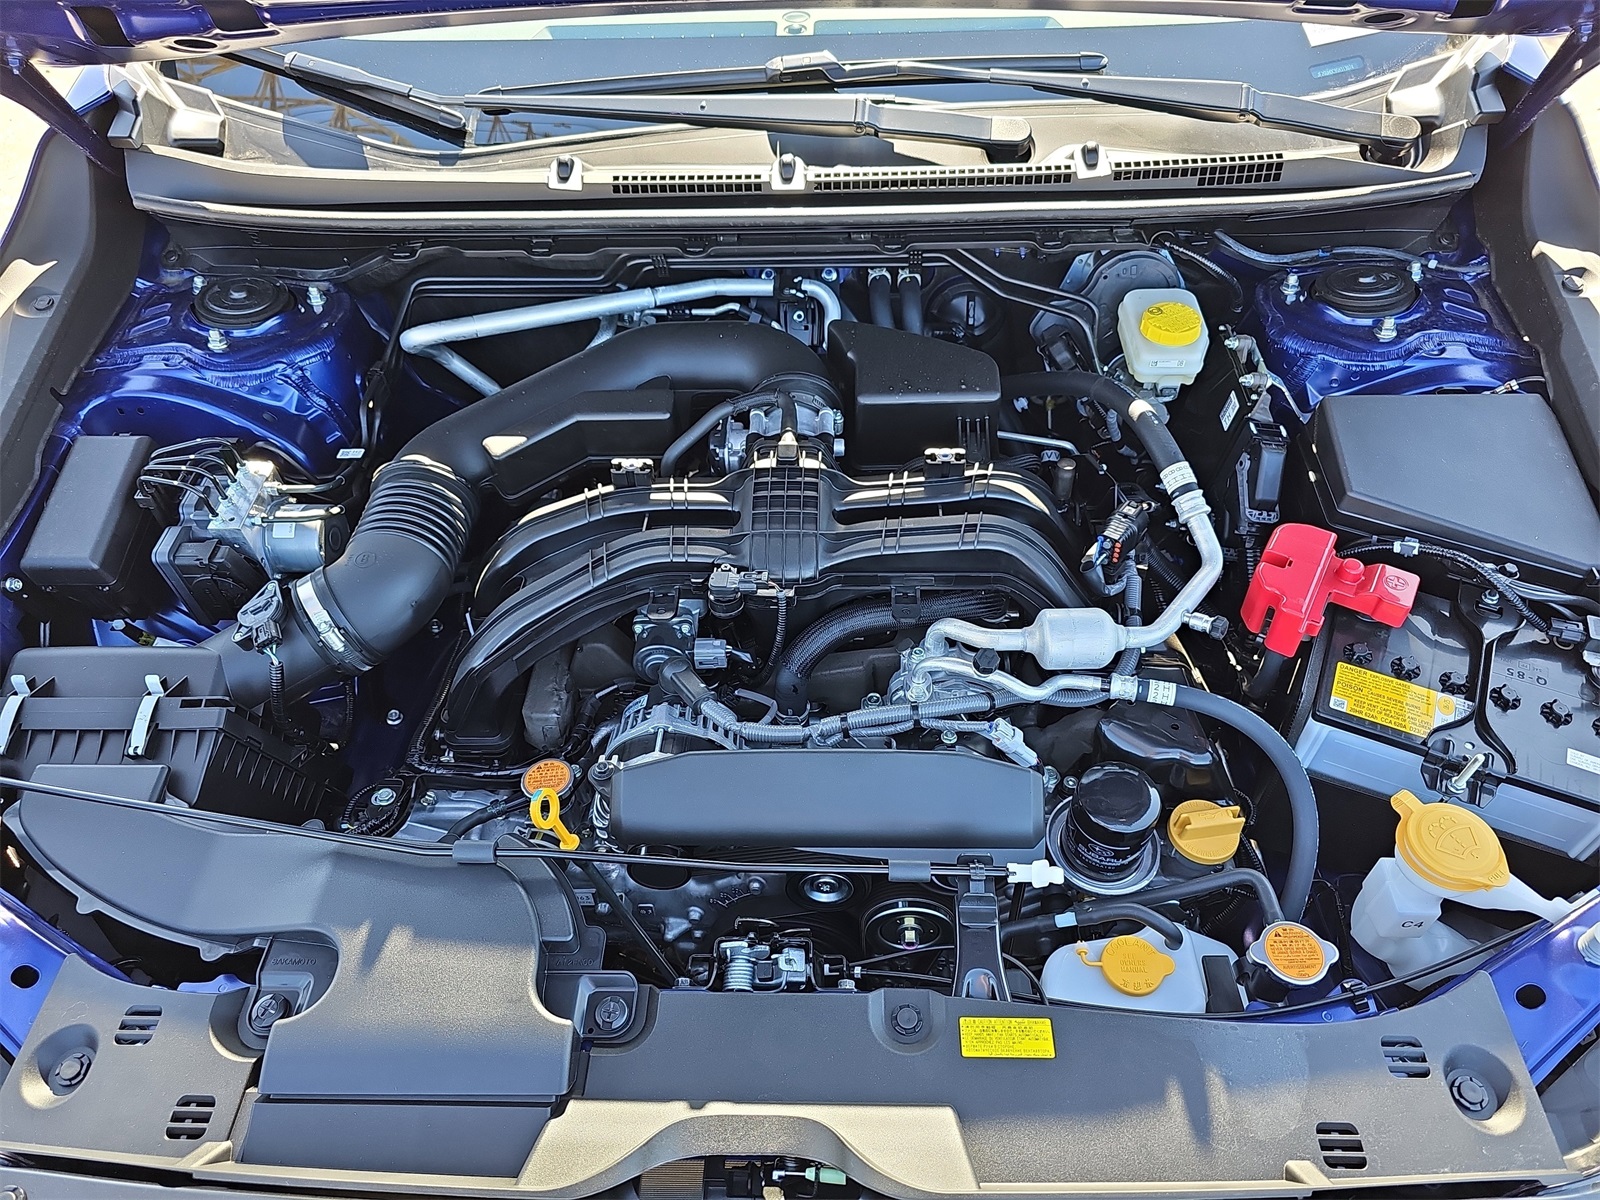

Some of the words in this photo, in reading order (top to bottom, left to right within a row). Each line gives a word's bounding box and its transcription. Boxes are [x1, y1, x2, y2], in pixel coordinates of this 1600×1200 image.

[1340, 664, 1368, 676] DANGER
[1506, 667, 1548, 686] Q-85
[1336, 680, 1364, 693] POISON
[1078, 843, 1122, 863] SUBARU
[1401, 920, 1424, 928] C4
[1105, 938, 1156, 957] COOLANT
